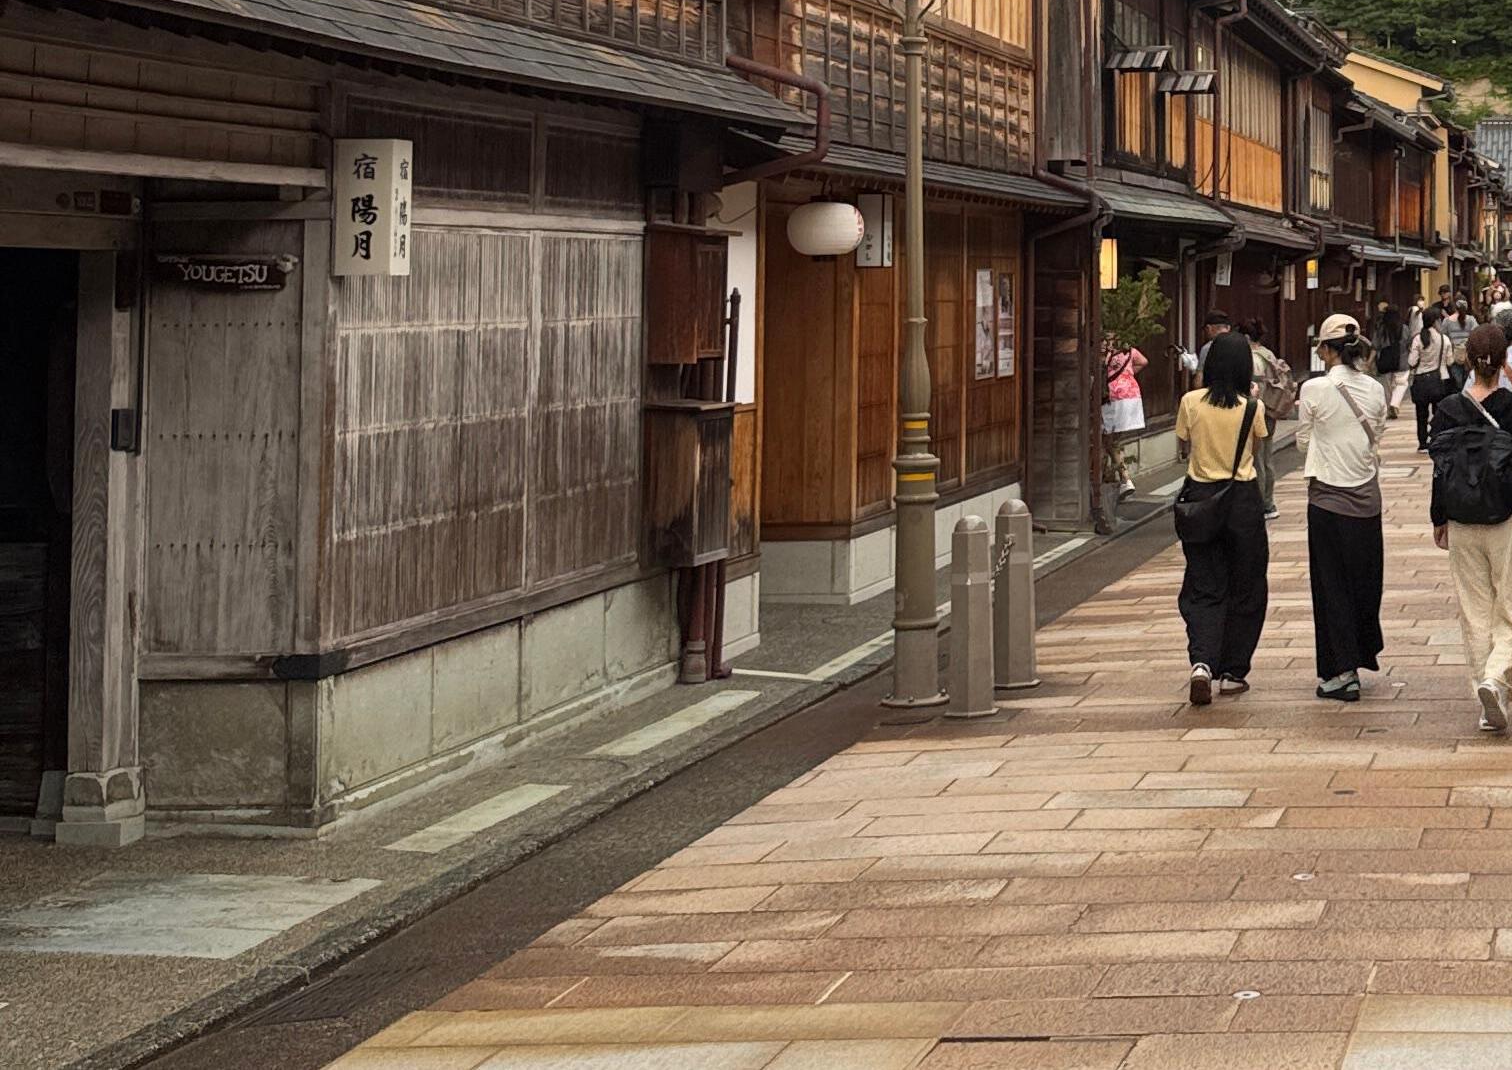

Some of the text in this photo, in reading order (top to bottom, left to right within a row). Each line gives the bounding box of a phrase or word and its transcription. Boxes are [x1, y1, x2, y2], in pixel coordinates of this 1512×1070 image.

[351, 153, 379, 260] 宿陽月
[178, 264, 268, 284] YOUGETSU
